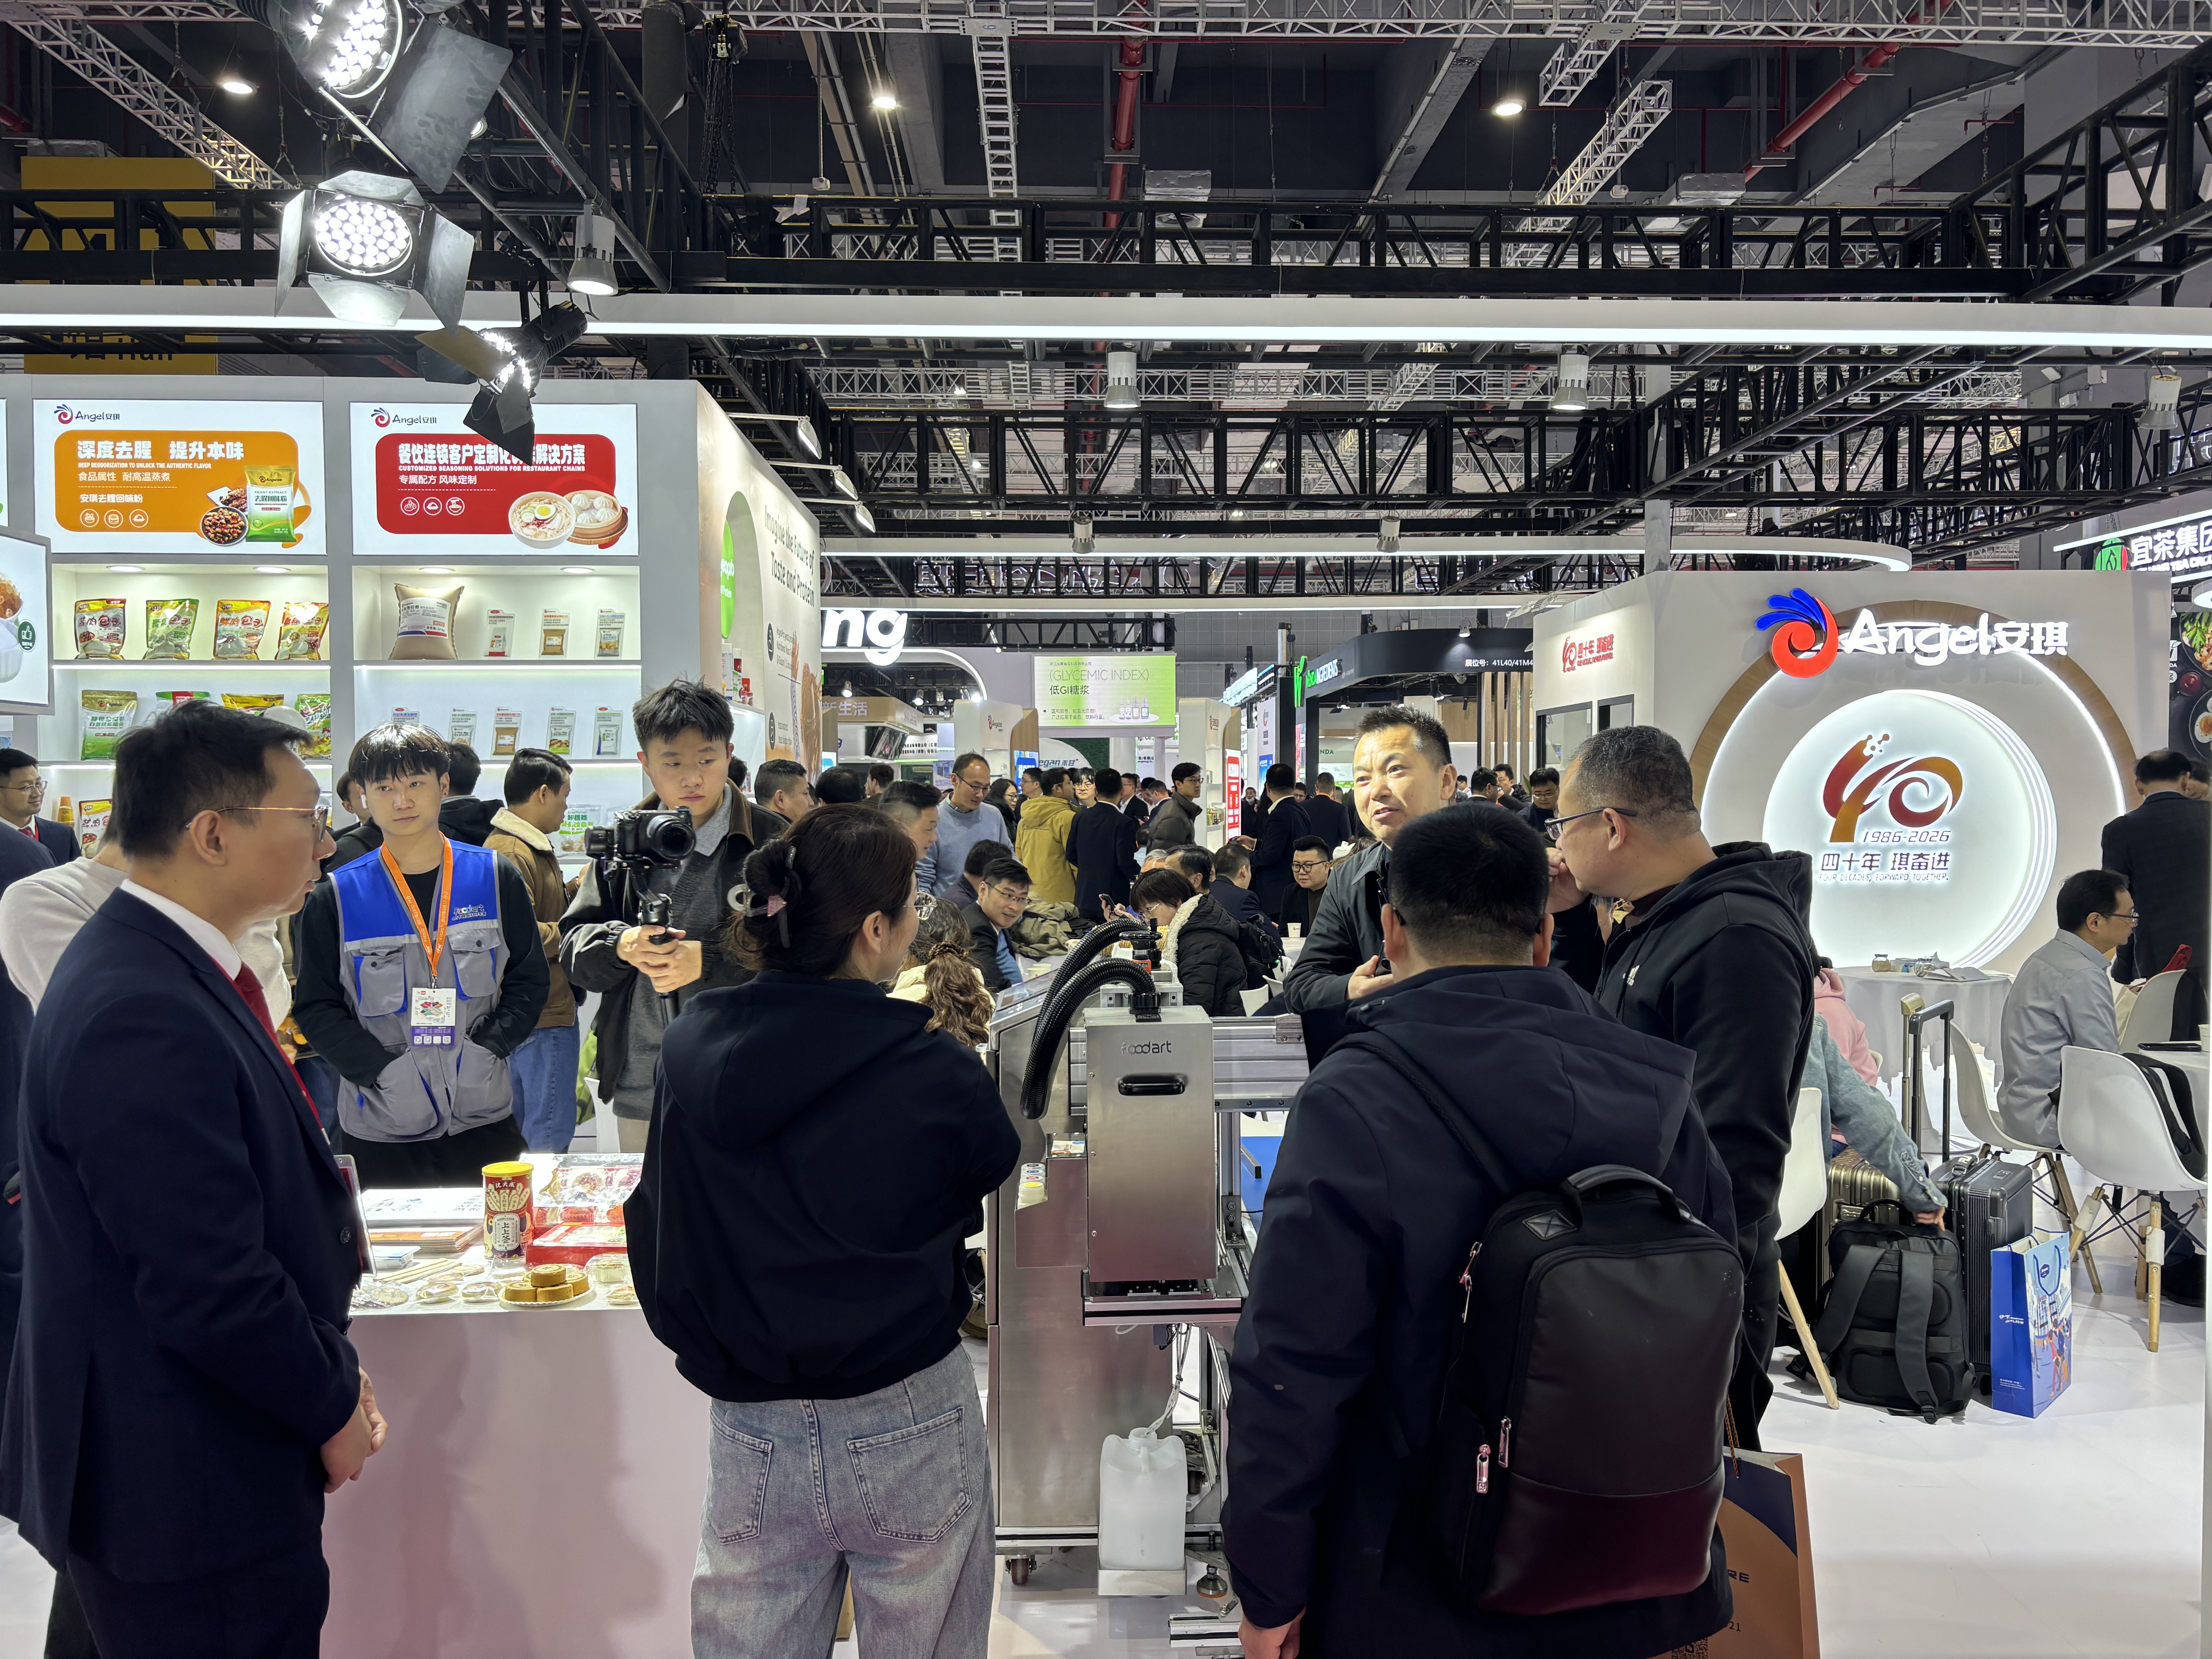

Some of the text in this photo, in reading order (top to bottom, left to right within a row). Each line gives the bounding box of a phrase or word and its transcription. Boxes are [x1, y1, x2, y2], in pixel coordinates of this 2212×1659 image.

[77, 440, 244, 460] 深度去腥 提升本味
[398, 443, 586, 465] 餐饮连锁客户定制化解决方案
[78, 472, 171, 482] 食品属性 耐高温蒸煮
[398, 474, 477, 484] 专属配方 风味定制
[765, 505, 785, 544] Imagine
[794, 534, 809, 566] Future
[809, 550, 815, 576] of
[771, 550, 815, 608] Taste and Protein
[1050, 669, 1149, 682] (GLYCEMIC INDEX)
[1049, 685, 1090, 695] 低GI糖浆
[1863, 830, 1951, 843] 1986-2026
[1821, 852, 1951, 871] 四十年 琪奋进
[1840, 874, 1872, 882] DECADES,
[1120, 1040, 1172, 1056] foodart
